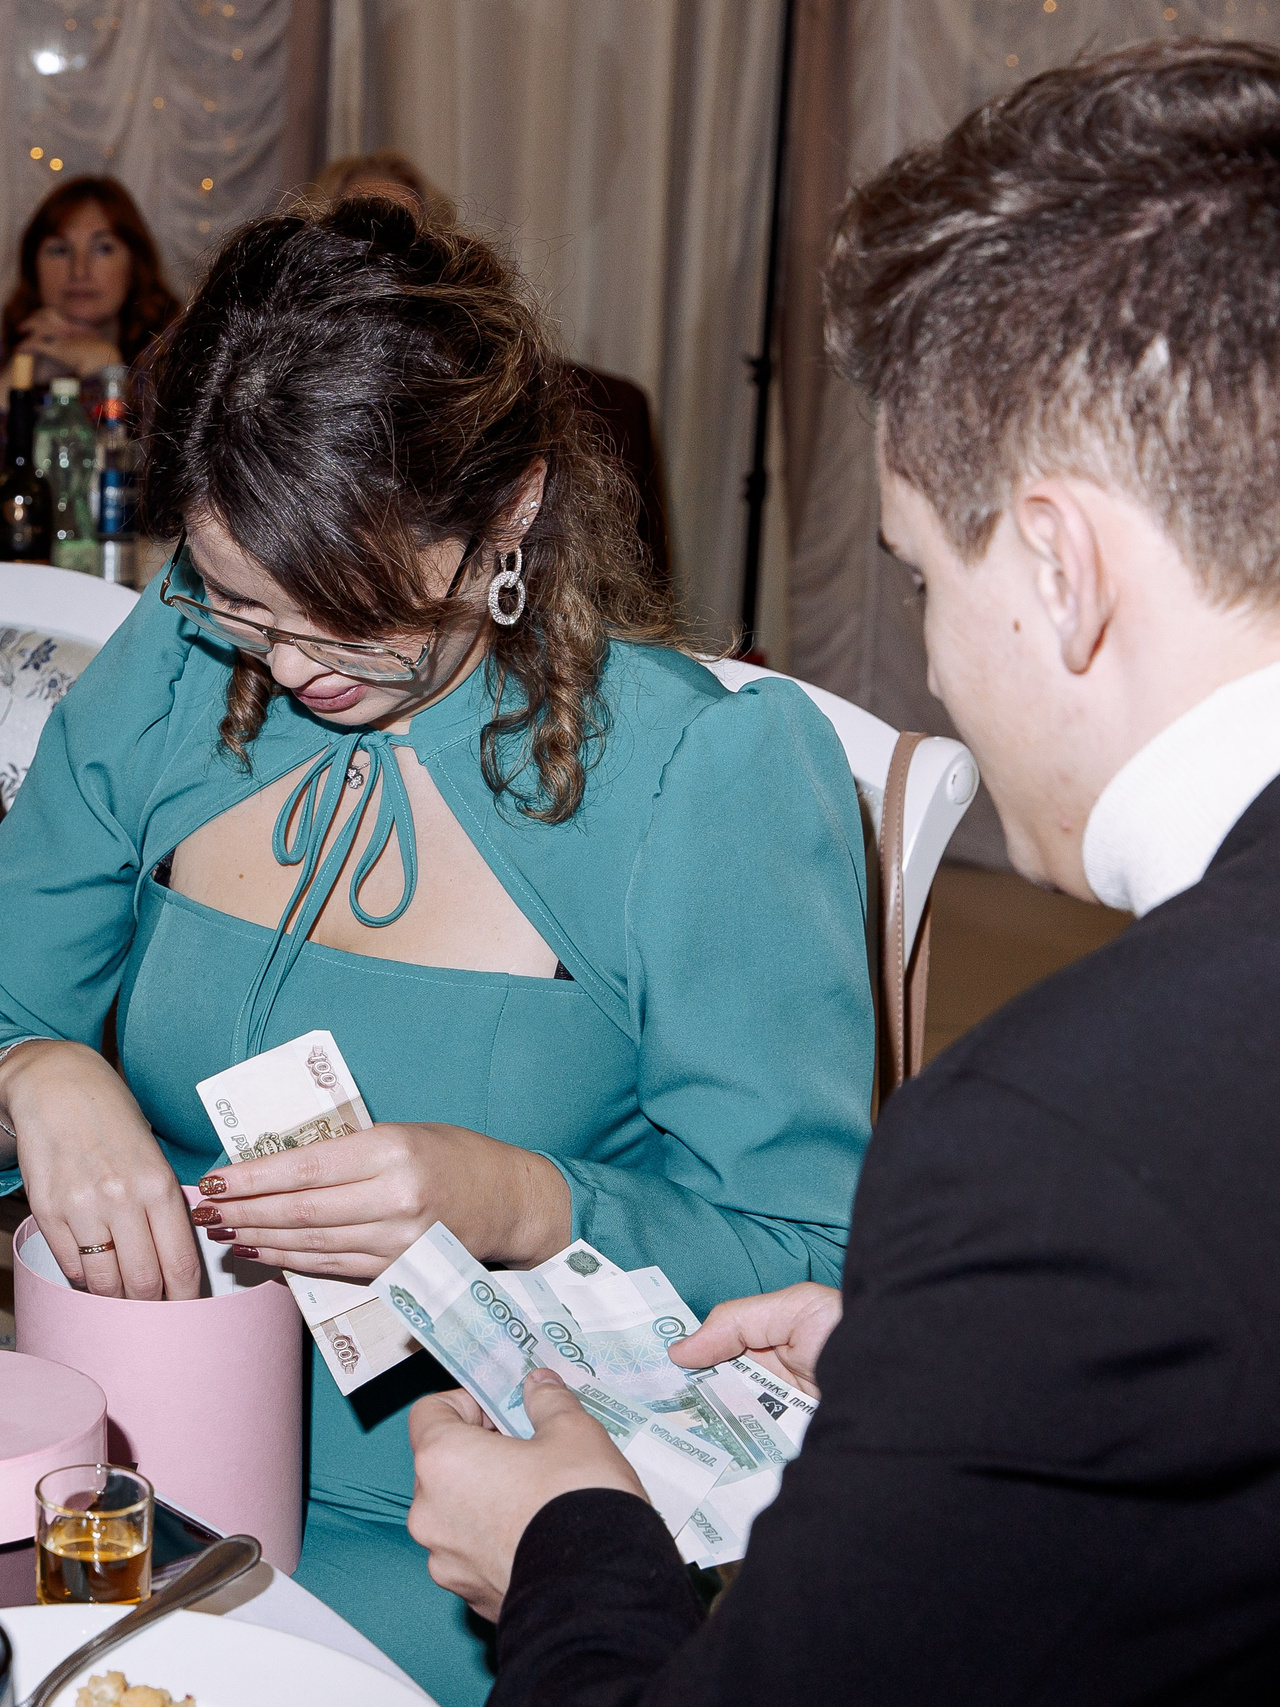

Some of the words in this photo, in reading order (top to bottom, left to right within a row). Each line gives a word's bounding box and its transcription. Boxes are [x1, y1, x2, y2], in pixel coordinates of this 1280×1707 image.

[308, 1053, 337, 1088] 100
[216, 1099, 238, 1128] СТО
[231, 1134, 255, 1161] РУБ
[394, 1296, 427, 1328] 1000
[470, 1280, 538, 1357] 1000
[333, 1336, 358, 1367] 100
[730, 1358, 750, 1375] ЛЕТ
[750, 1371, 788, 1399] БАНКА
[579, 1383, 648, 1425] РУБЛЕЙ
[651, 1423, 718, 1468] ТЫСЯЧА
[738, 1414, 790, 1465] РУБЛЕЙ
[691, 1508, 722, 1544] ТЫС
